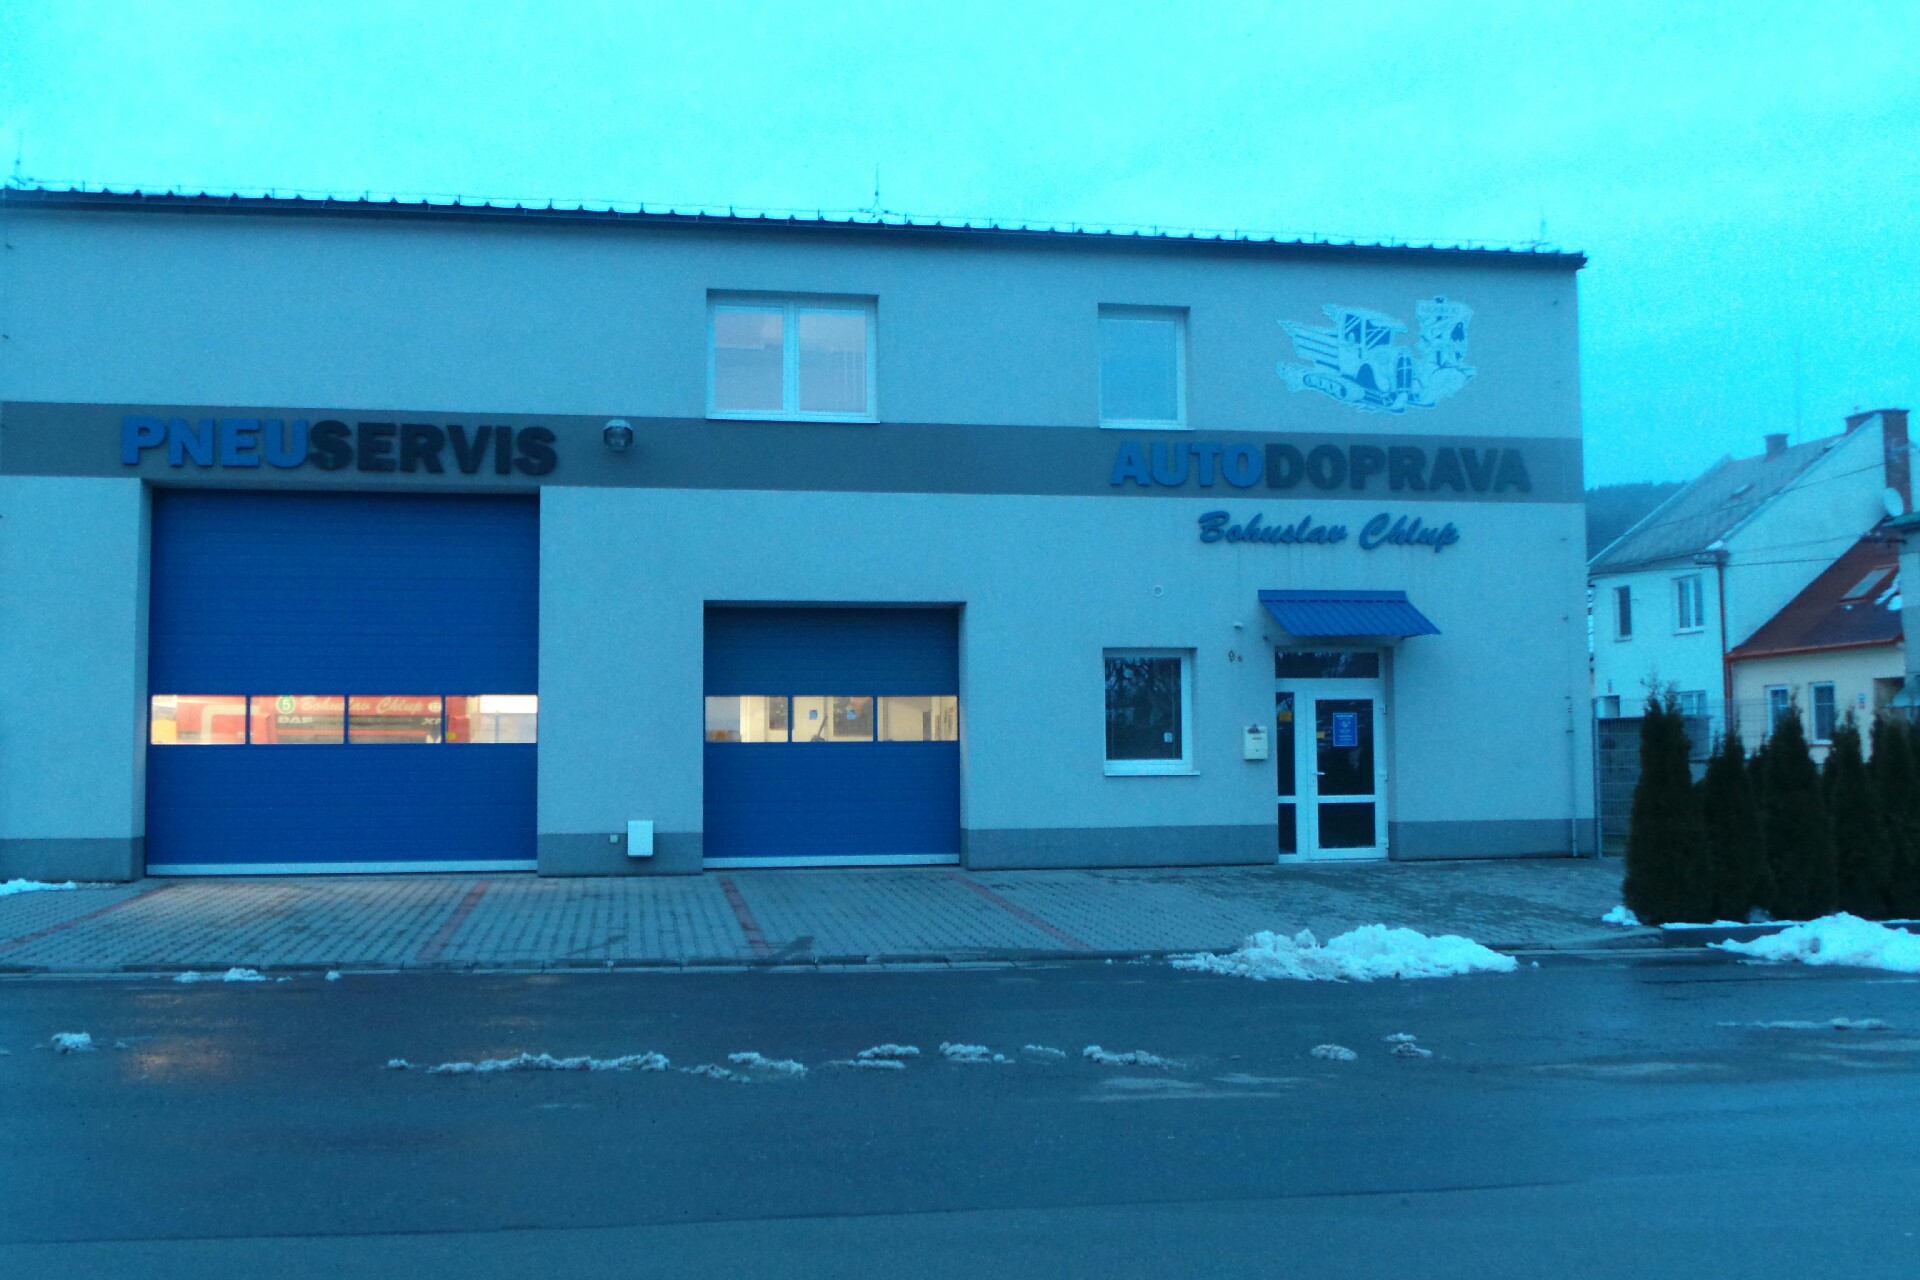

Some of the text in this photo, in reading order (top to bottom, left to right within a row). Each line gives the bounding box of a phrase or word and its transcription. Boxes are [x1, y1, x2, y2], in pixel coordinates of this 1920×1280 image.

[121, 415, 558, 476] PNEUSERVIS
[1110, 440, 1531, 493] AUTODOPRAVA
[1198, 510, 1459, 553] Bohuslav Chlup
[282, 697, 291, 710] 5
[301, 696, 370, 712] Bohulav
[375, 697, 424, 715] Chlup
